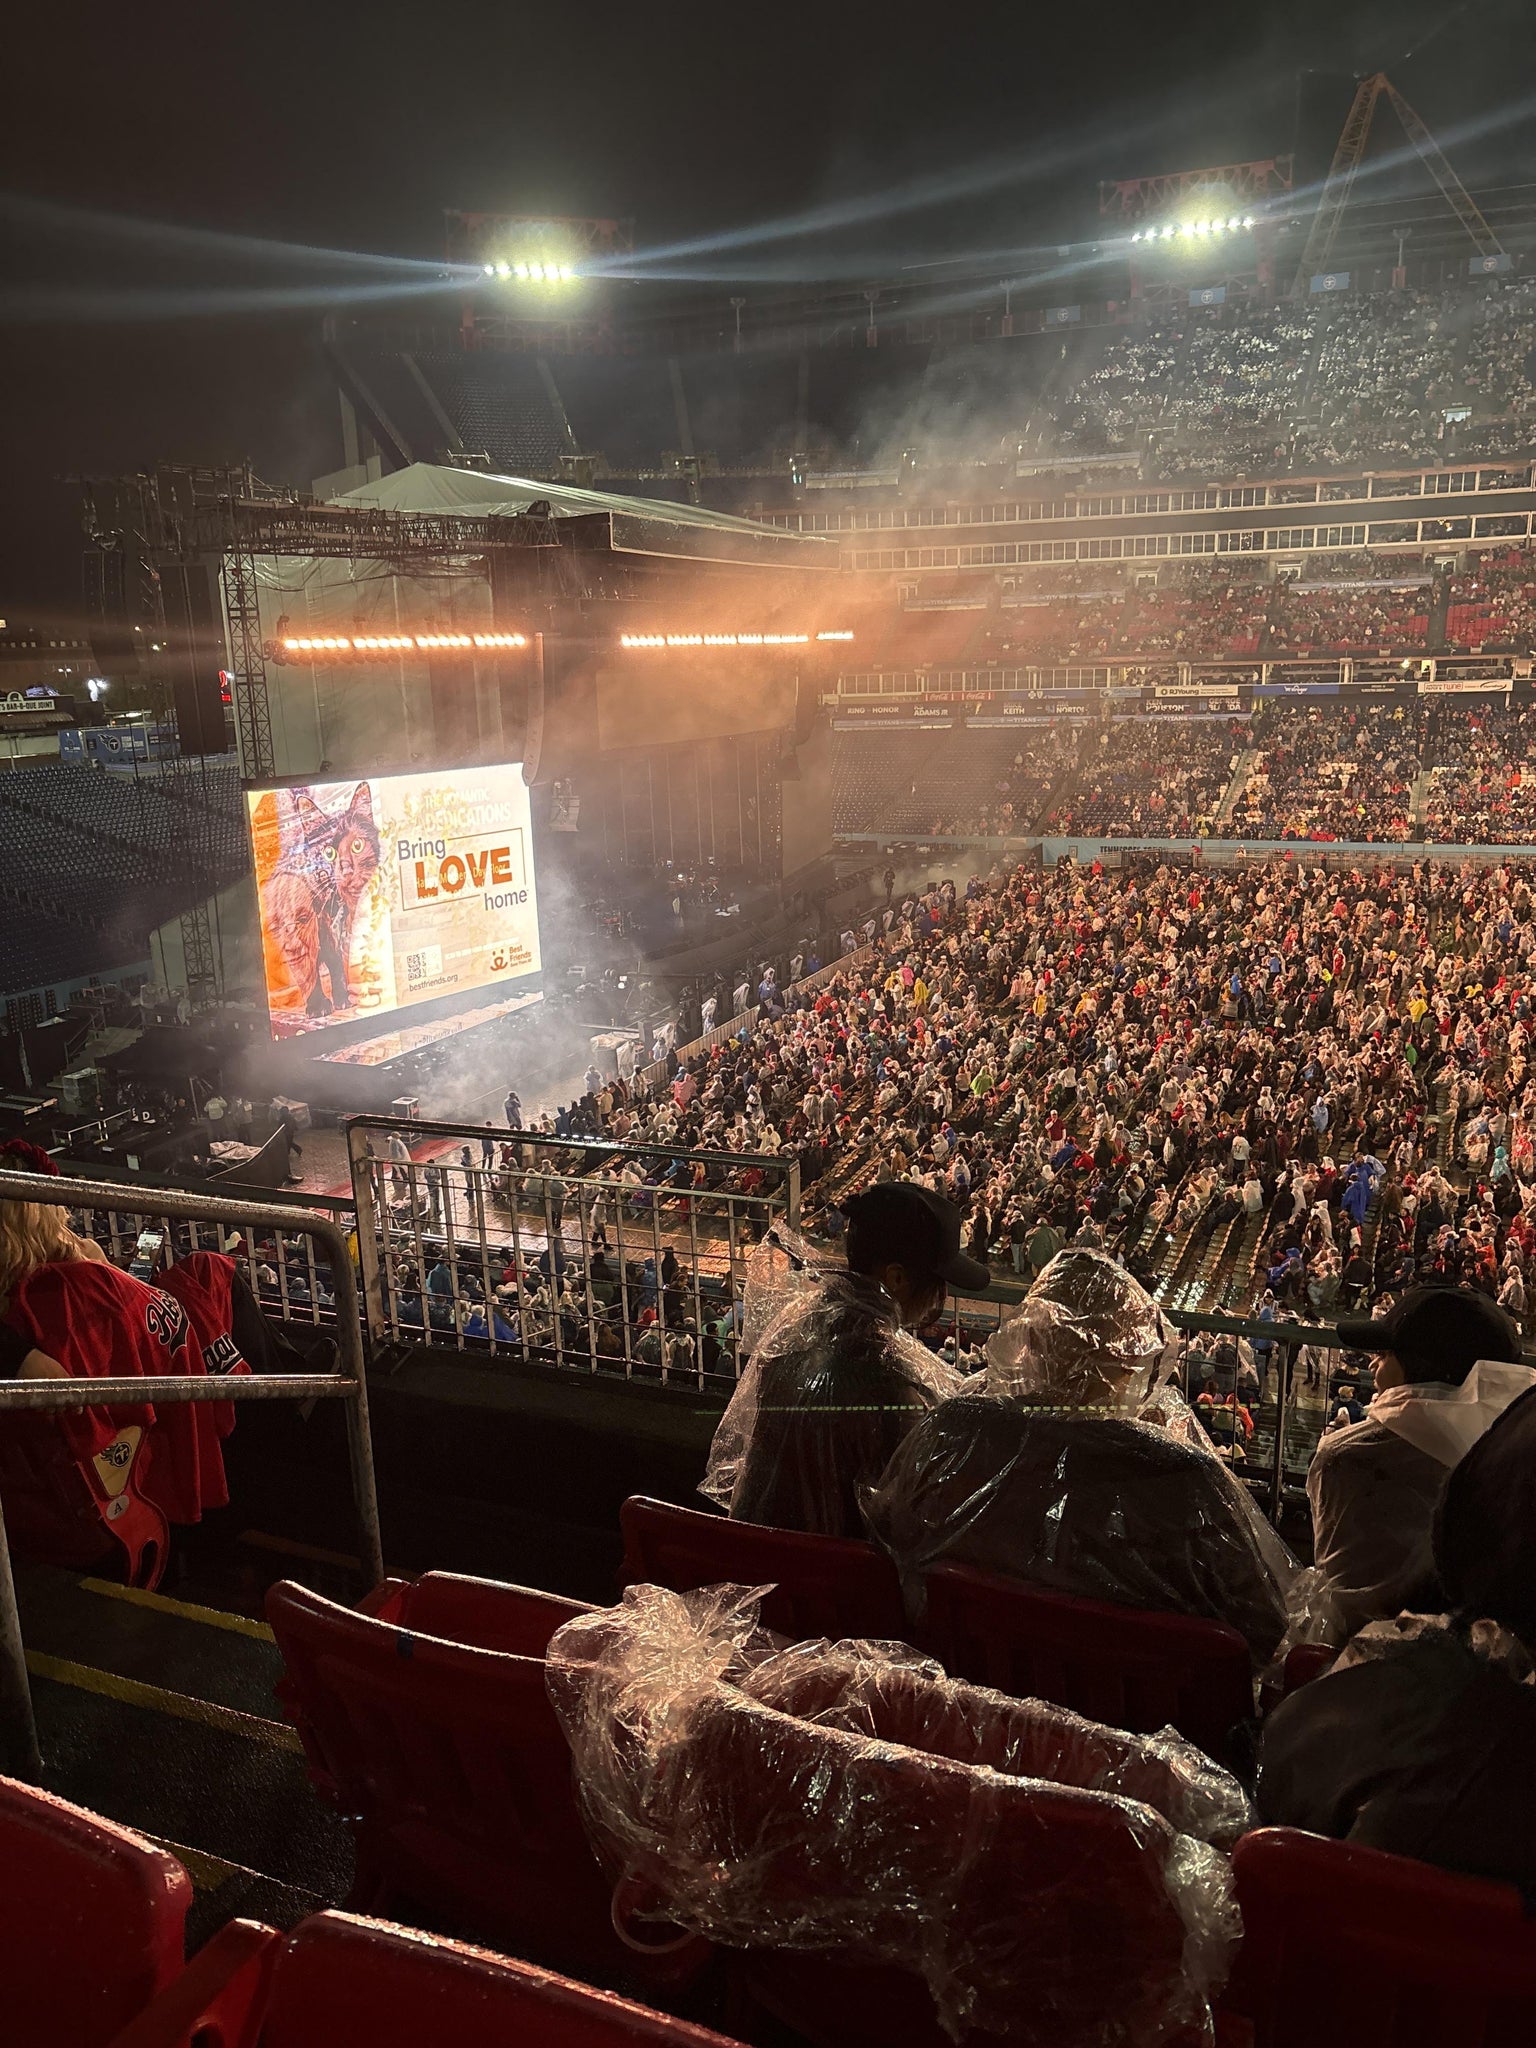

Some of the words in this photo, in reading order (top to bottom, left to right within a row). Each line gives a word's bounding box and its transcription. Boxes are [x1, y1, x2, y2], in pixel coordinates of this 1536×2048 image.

[872, 706, 899, 714] HONOR
[914, 709, 940, 717] ADAMS
[425, 802, 512, 832] DEDICATIONS
[397, 837, 446, 860] Bring
[415, 847, 512, 899] LOVE
[484, 889, 528, 911] home
[509, 945, 523, 954] Best
[509, 951, 532, 962] Friends
[409, 973, 459, 992] bestfriends.org
